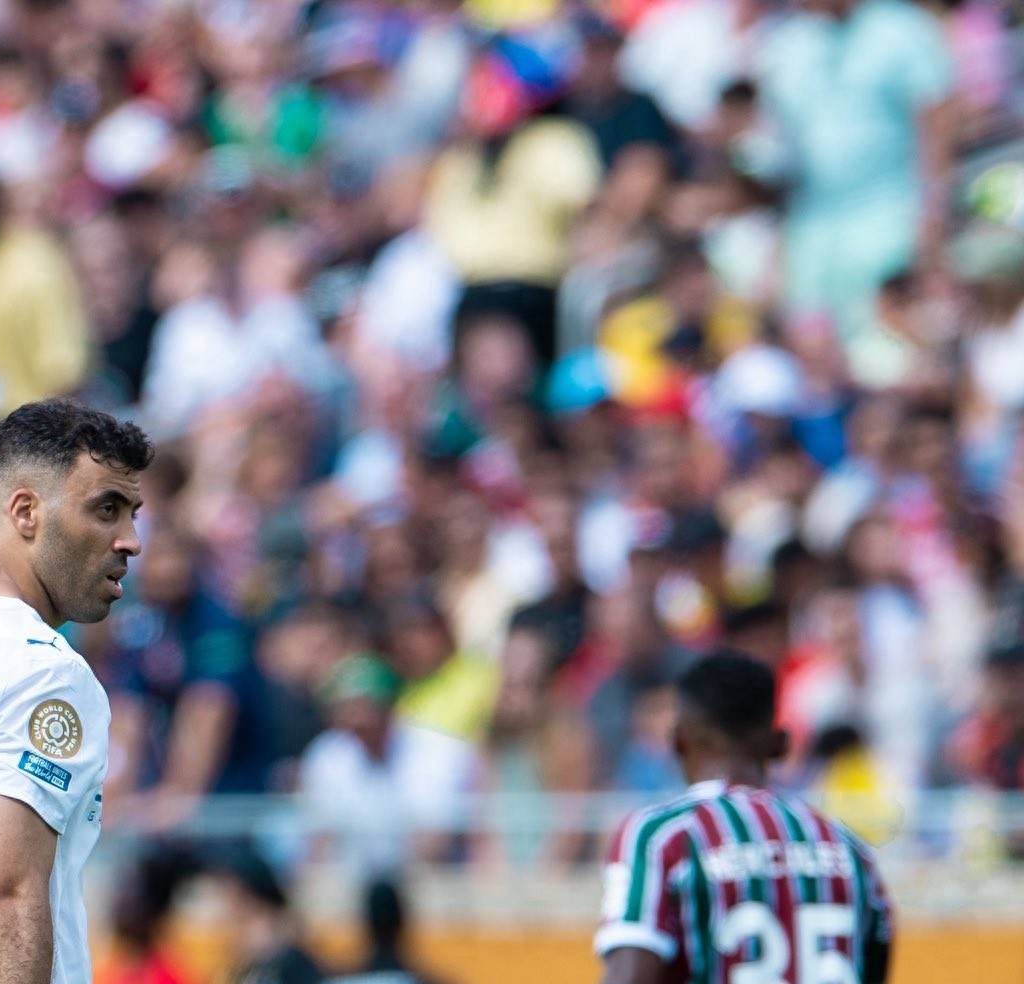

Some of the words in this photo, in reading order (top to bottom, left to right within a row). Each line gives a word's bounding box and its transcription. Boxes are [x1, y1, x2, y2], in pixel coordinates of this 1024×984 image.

[38, 705, 64, 719] WORLD
[64, 709, 76, 724] CUP
[33, 719, 42, 740] CLUB
[72, 726, 78, 737] 25
[42, 742, 63, 757] FIFA
[65, 738, 77, 752] USA
